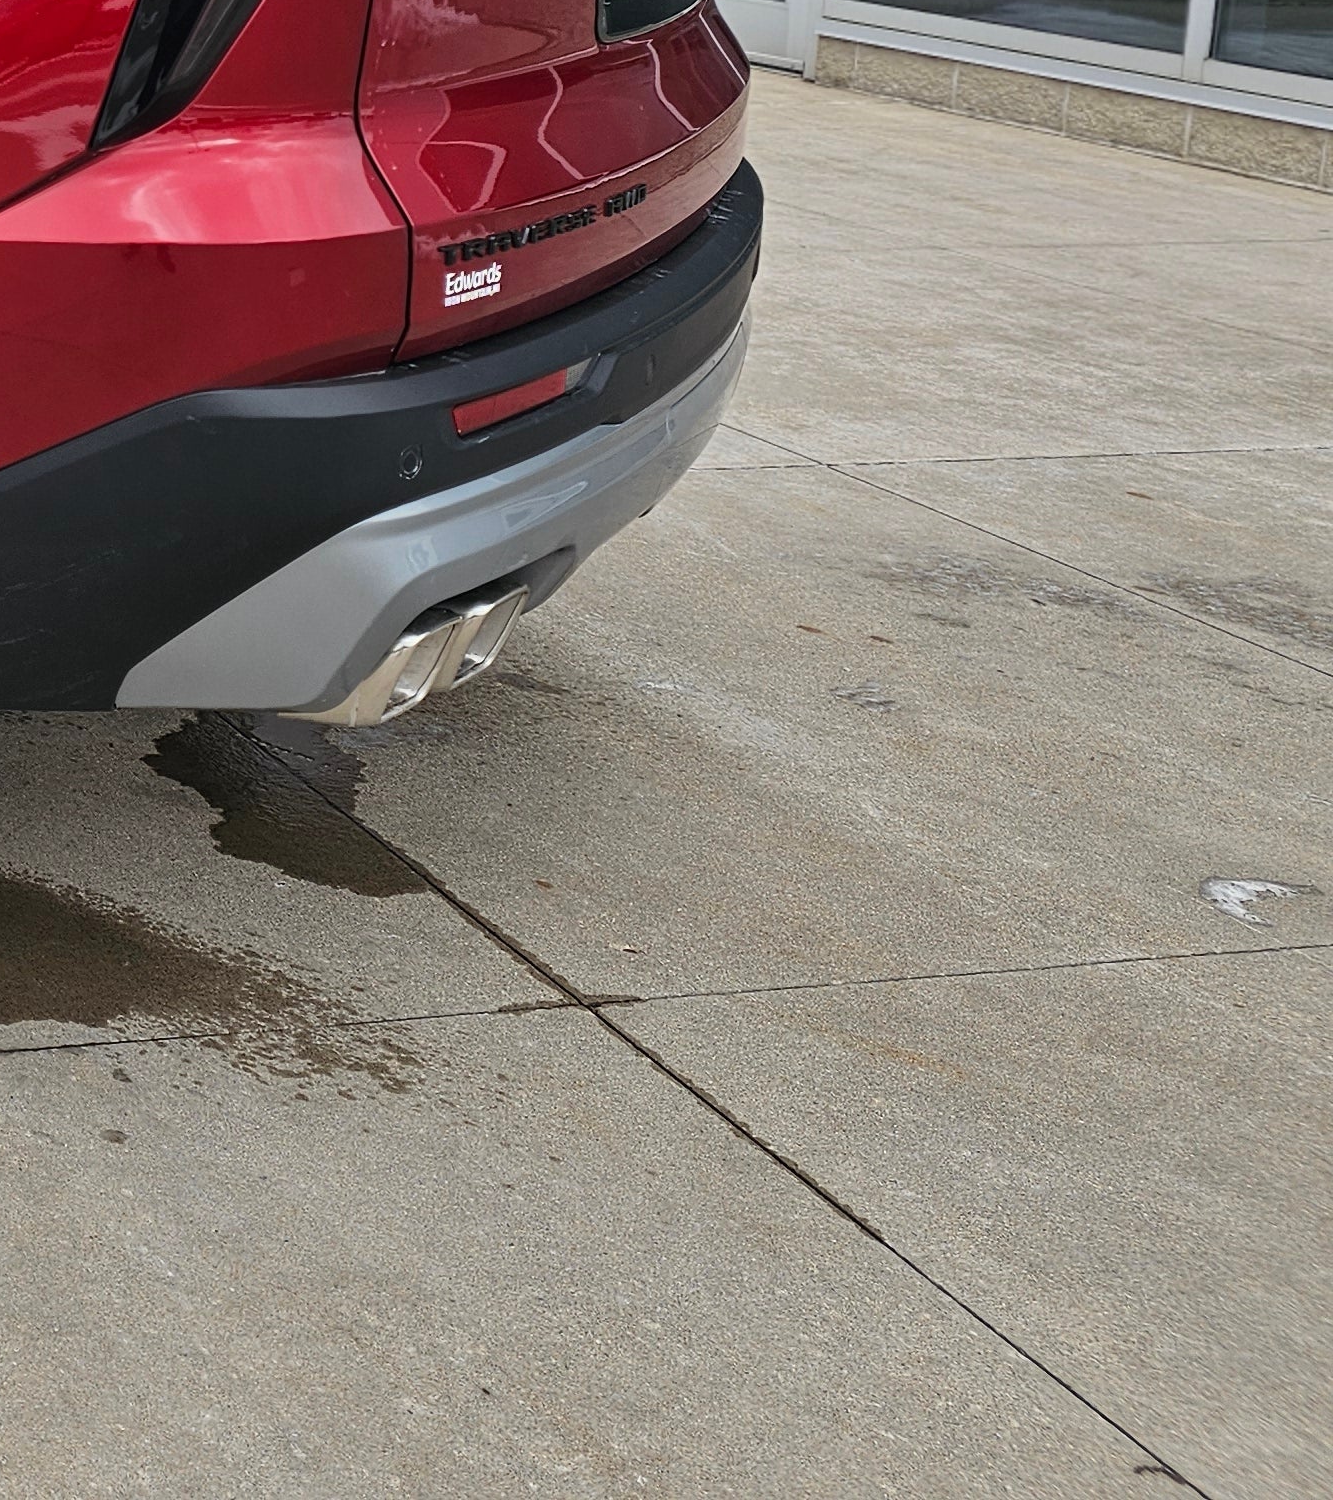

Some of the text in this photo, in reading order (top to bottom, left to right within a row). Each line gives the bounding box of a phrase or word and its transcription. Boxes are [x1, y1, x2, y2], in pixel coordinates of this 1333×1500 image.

[437, 184, 647, 266] TRAVERSE AWD
[445, 261, 502, 296] Edwards
